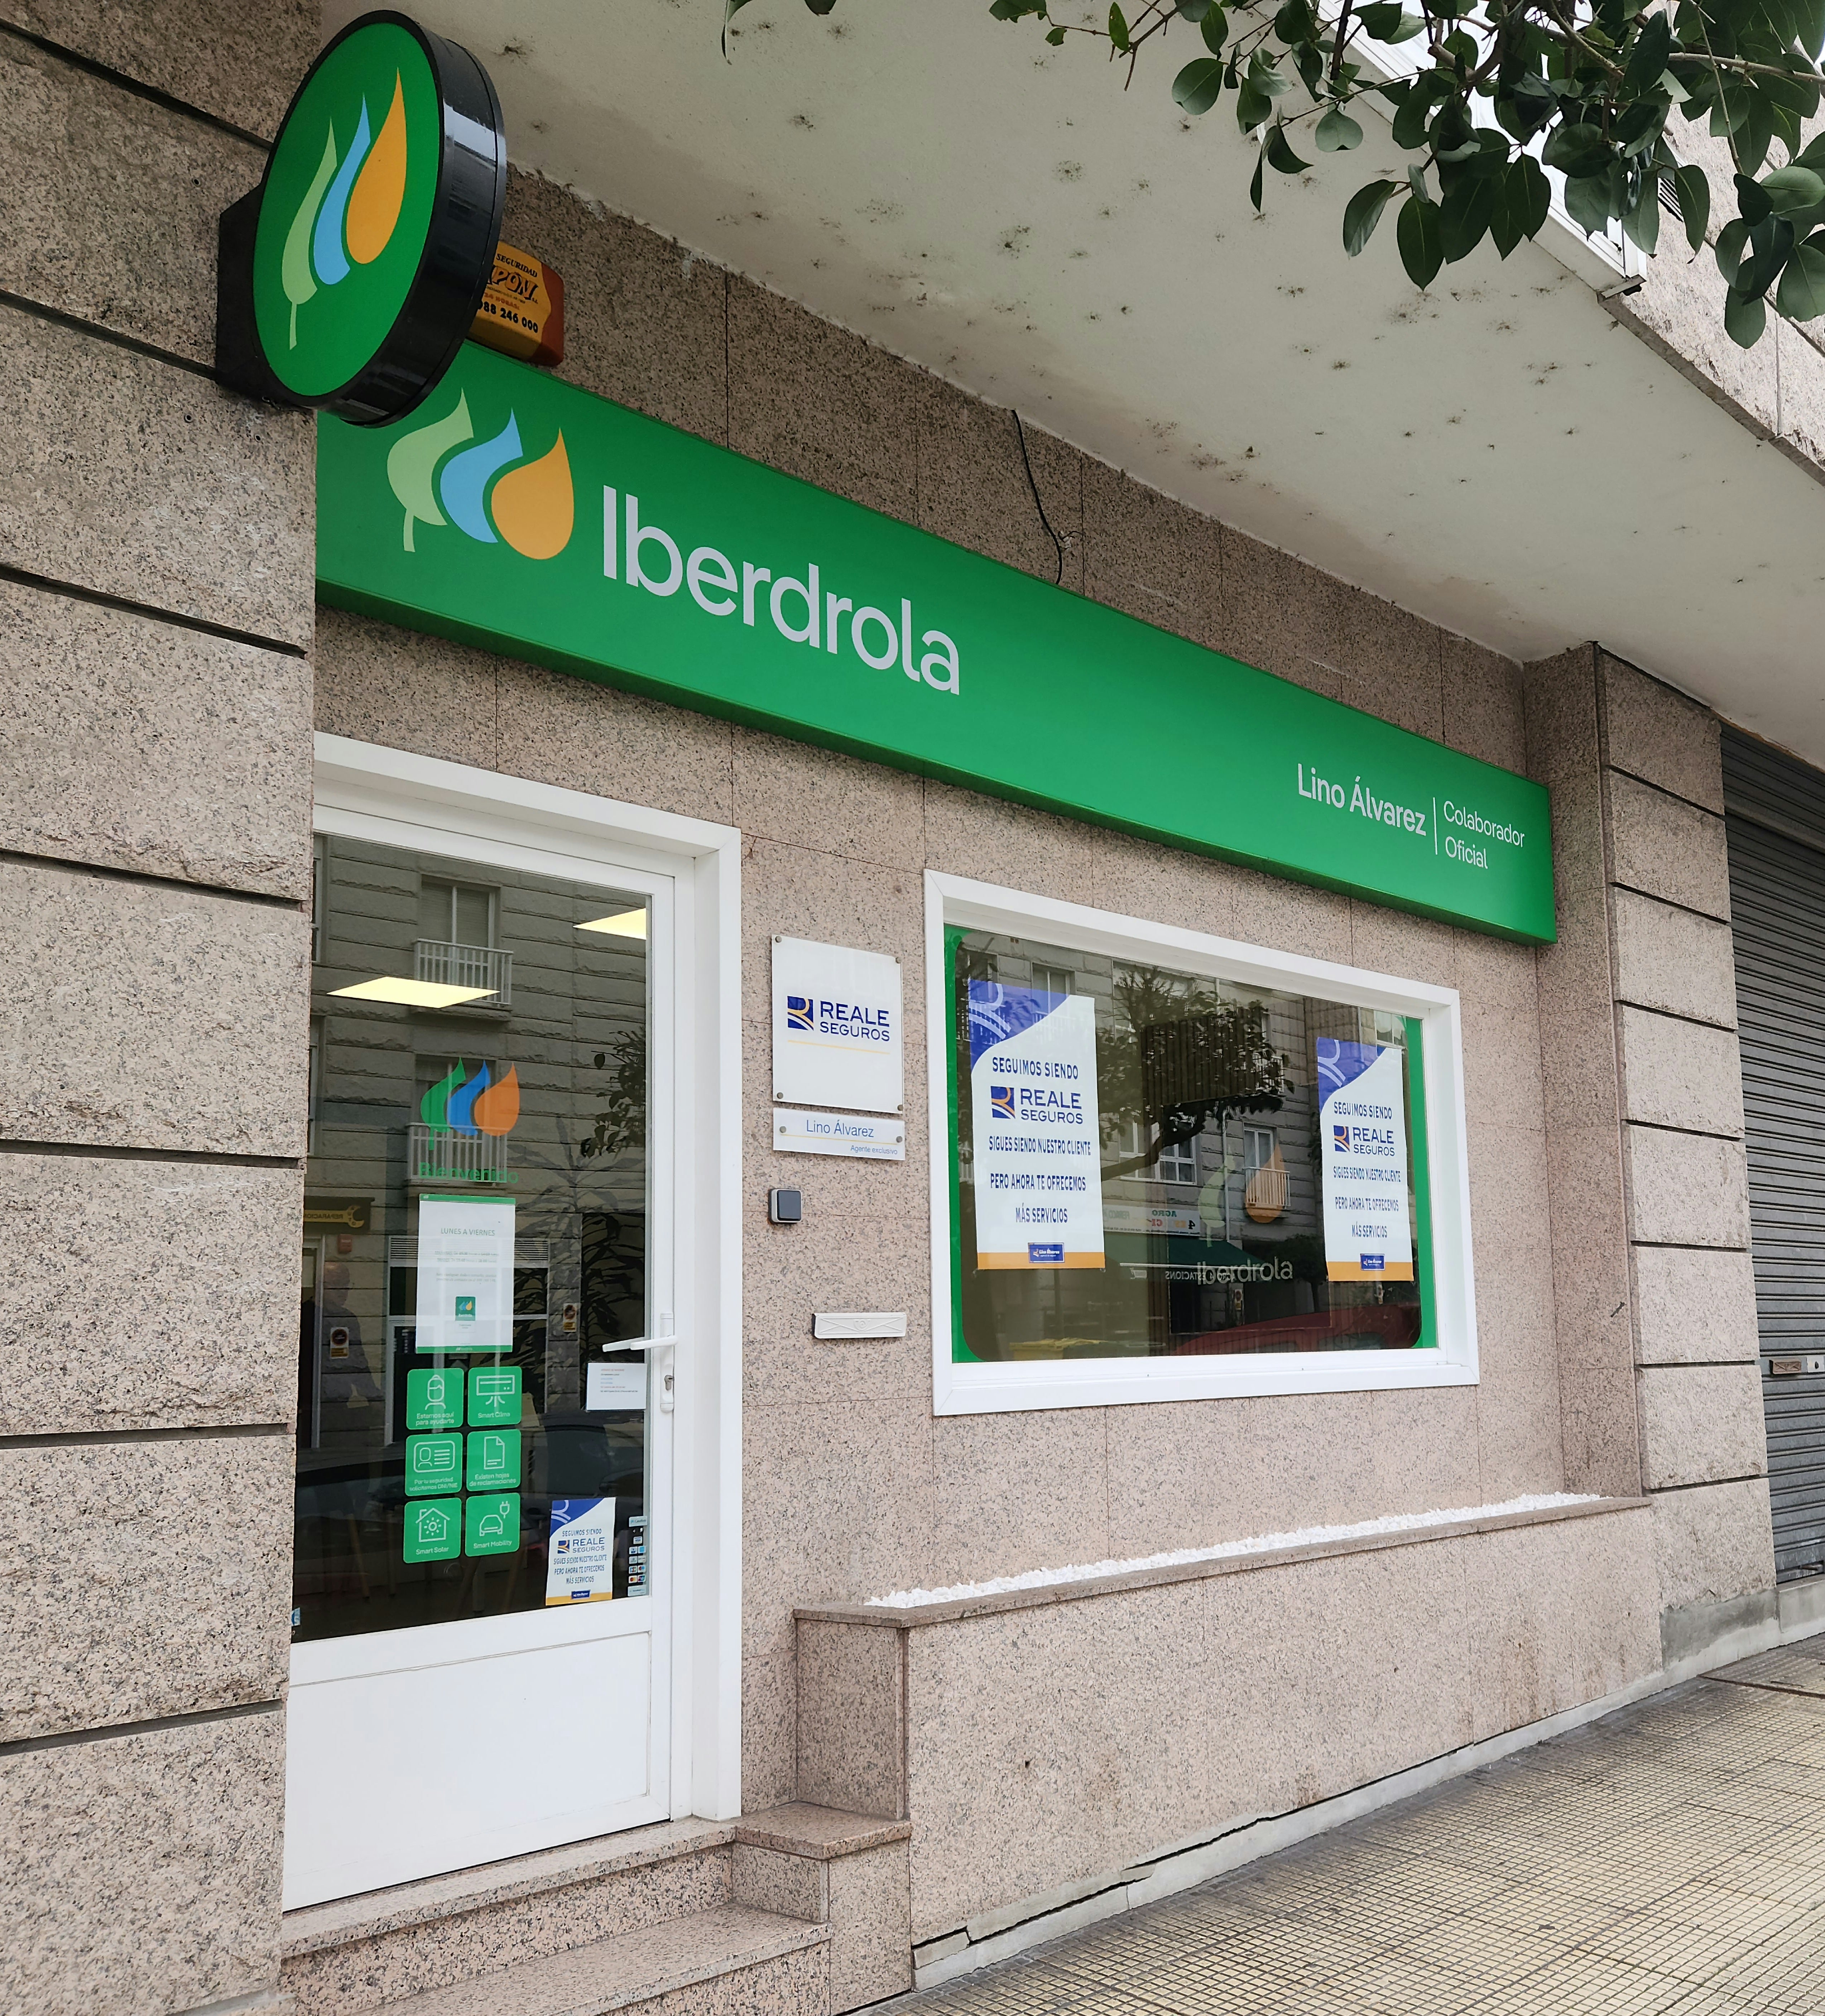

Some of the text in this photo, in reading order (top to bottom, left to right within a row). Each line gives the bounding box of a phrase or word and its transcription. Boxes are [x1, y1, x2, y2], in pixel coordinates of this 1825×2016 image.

[496, 253, 537, 277] SEGURIDAD
[500, 307, 519, 323] 246
[522, 317, 538, 333] 000
[604, 485, 959, 695] Iberdrola
[1298, 763, 1426, 836] Lino Álvarez
[1444, 801, 1525, 847] Colaborador
[1445, 836, 1488, 869] Oficial
[820, 1000, 889, 1027] REALE
[820, 1022, 890, 1042] SEGUROS
[993, 1057, 1078, 1080] SEGUIMOS SIENDO
[1020, 1088, 1082, 1109] REALE
[1021, 1109, 1083, 1124] SEGUROS
[1334, 1101, 1392, 1119] SEGUIMOS SIENDO
[806, 1120, 874, 1138] Lino Álvarez
[1353, 1127, 1394, 1144] REALE
[850, 1145, 898, 1155] Agente exclusivo
[989, 1136, 1091, 1156] SIGUES SIENDO NUESTRO CLIENTE
[1354, 1144, 1395, 1156] SEGUROS
[419, 1162, 519, 1184] Bienvenido
[990, 1173, 1086, 1191] PERO AHORA TE OFRECEMOS
[1334, 1166, 1401, 1182] SIGUES SIENDO NUESTRO CLIENTE
[1015, 1203, 1068, 1223] MÁS SERVICIOS
[1335, 1196, 1399, 1211] PERO AHORA TE OFRECEMOS
[1352, 1221, 1387, 1238] MÁS SERVICIOS
[1197, 1256, 1293, 1285] Iberdrola
[573, 1537, 605, 1546] REALE
